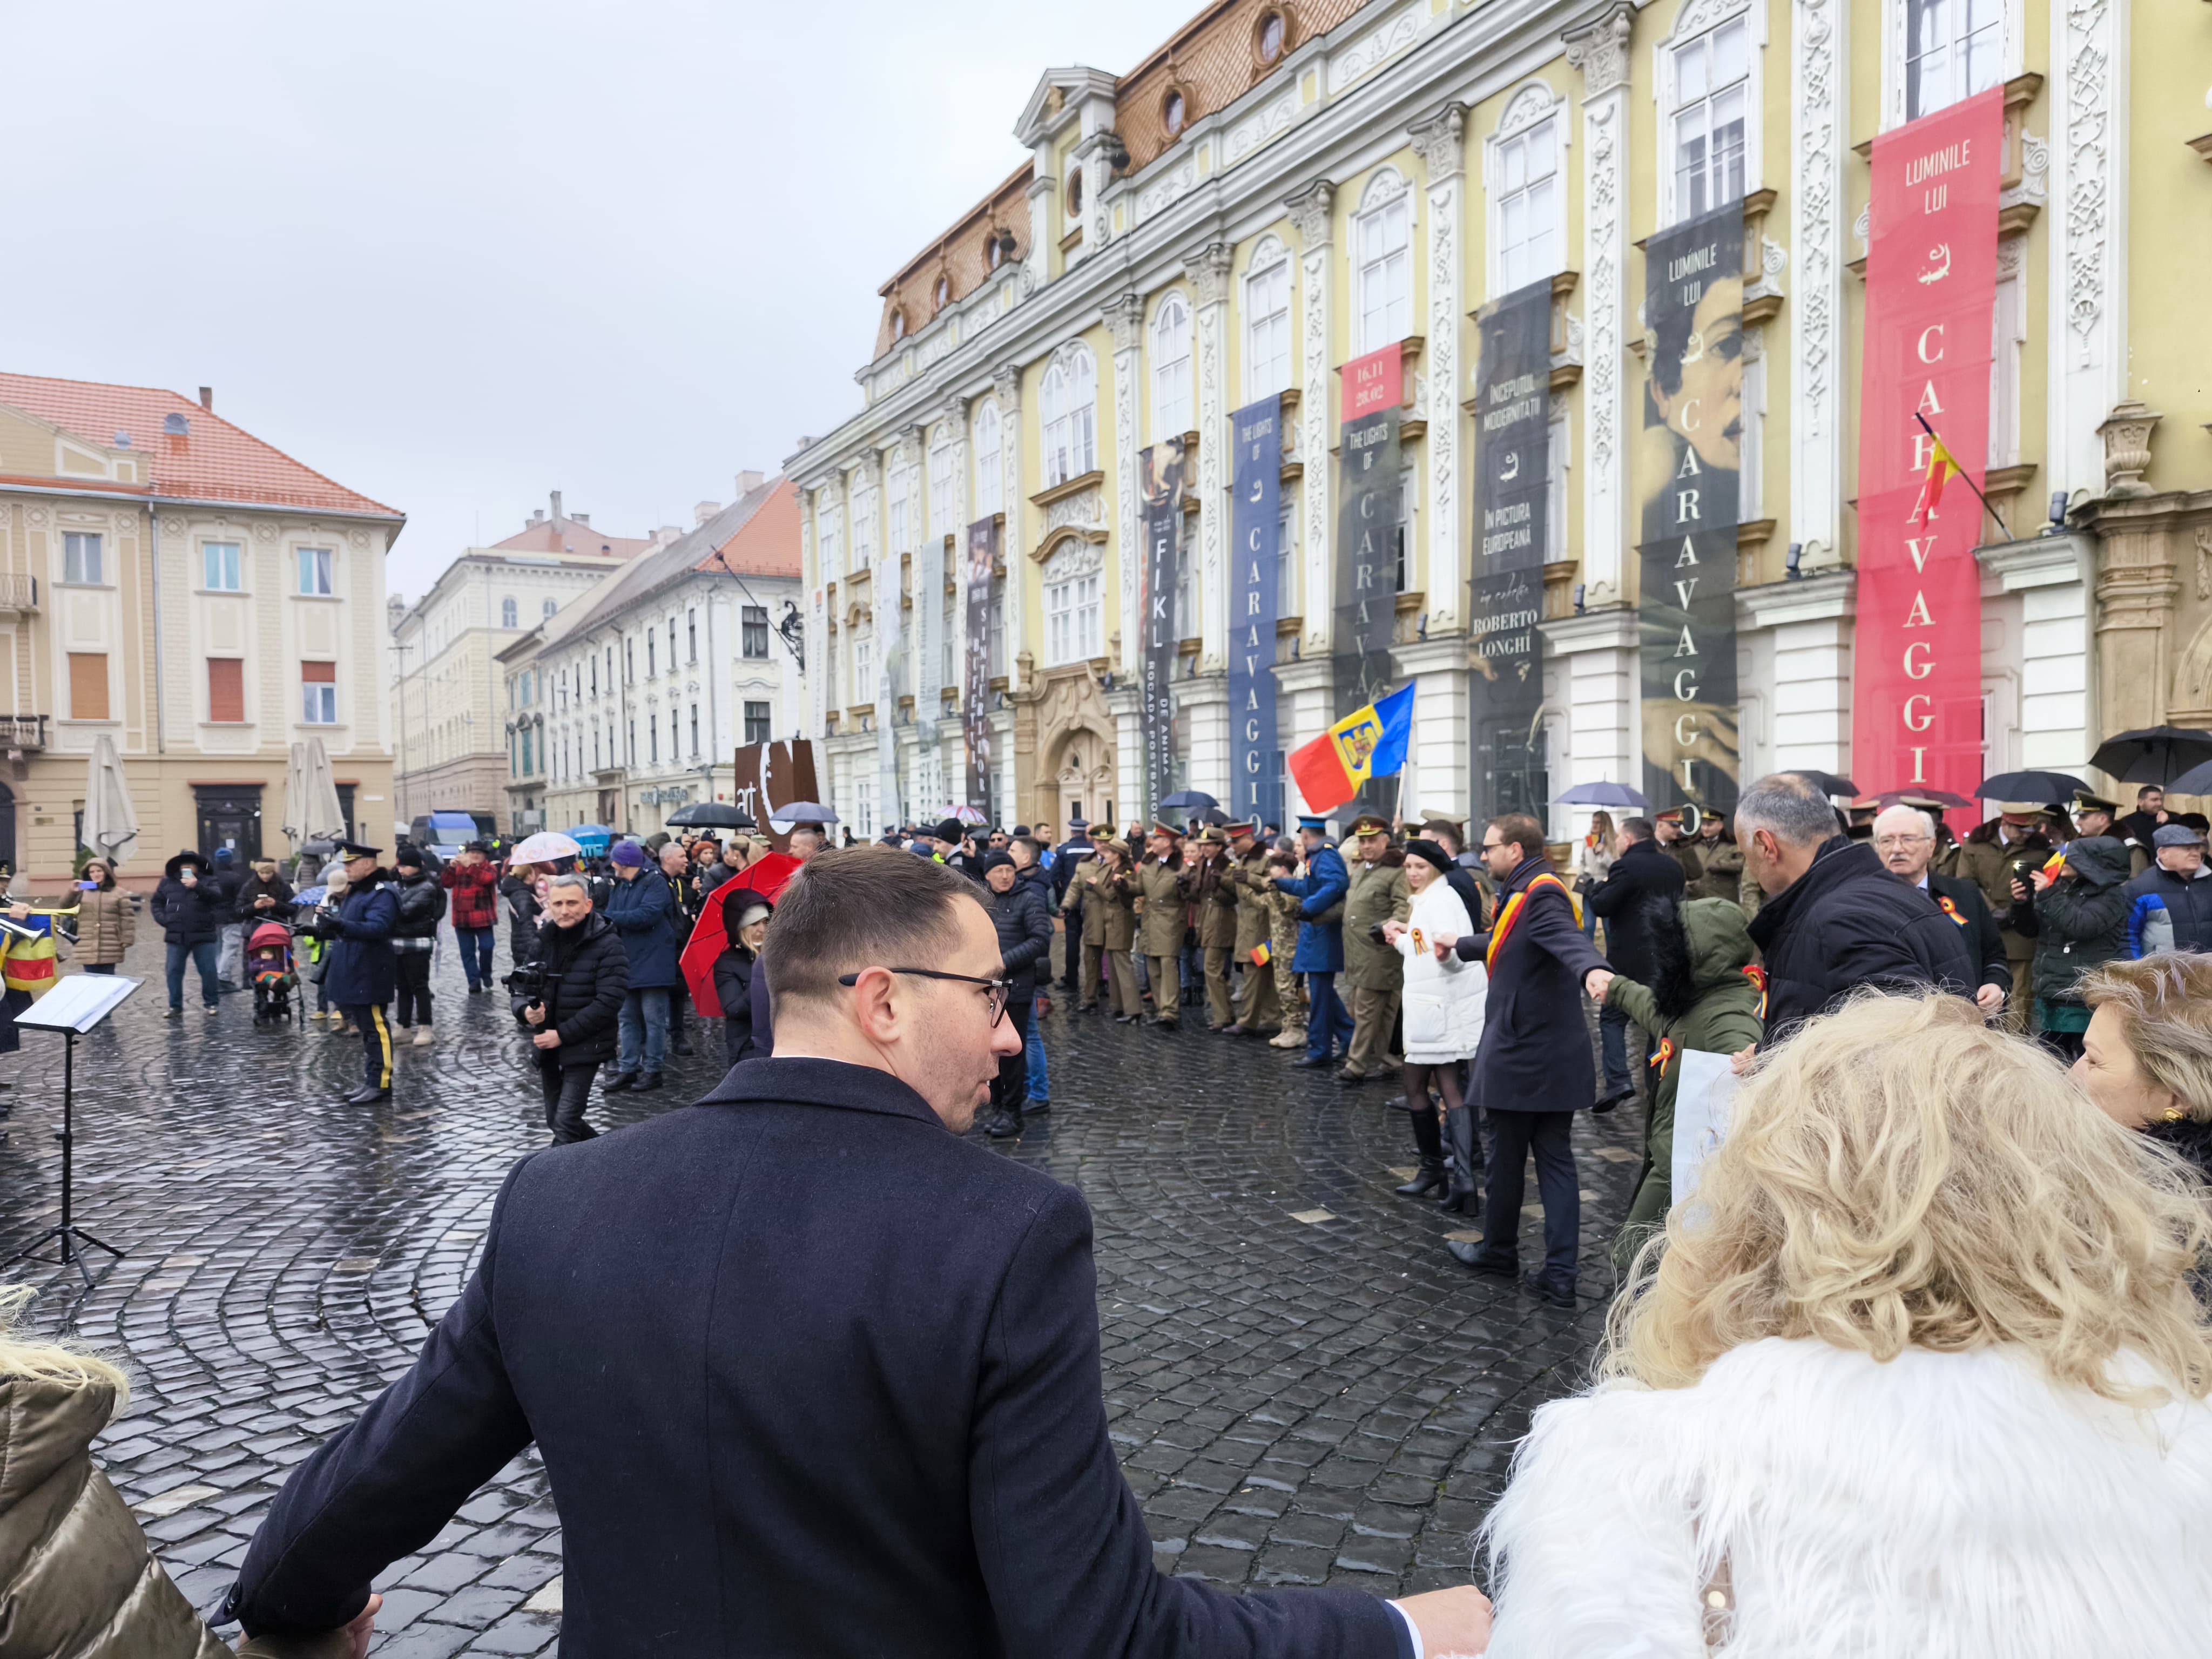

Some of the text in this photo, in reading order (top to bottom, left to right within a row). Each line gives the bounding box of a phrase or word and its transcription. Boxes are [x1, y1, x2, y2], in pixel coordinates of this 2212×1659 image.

[1906, 138, 1971, 187] LUMINILE
[1925, 183, 1947, 215] LUI
[1669, 242, 1716, 282] LUMINILE
[1684, 279, 1701, 306] LUI
[1357, 361, 1383, 383] 16.11
[1350, 422, 1388, 450] THE LIGHTS
[1363, 450, 1373, 470] OF
[1495, 501, 1530, 528] PICTURA
[1902, 324, 1944, 783] CARAVAGGI
[1153, 538, 1167, 648] FIKL
[1473, 609, 1537, 635] ROBERTO
[1478, 635, 1530, 659] LONGHI
[1159, 698, 1169, 775] DE ANIMA
